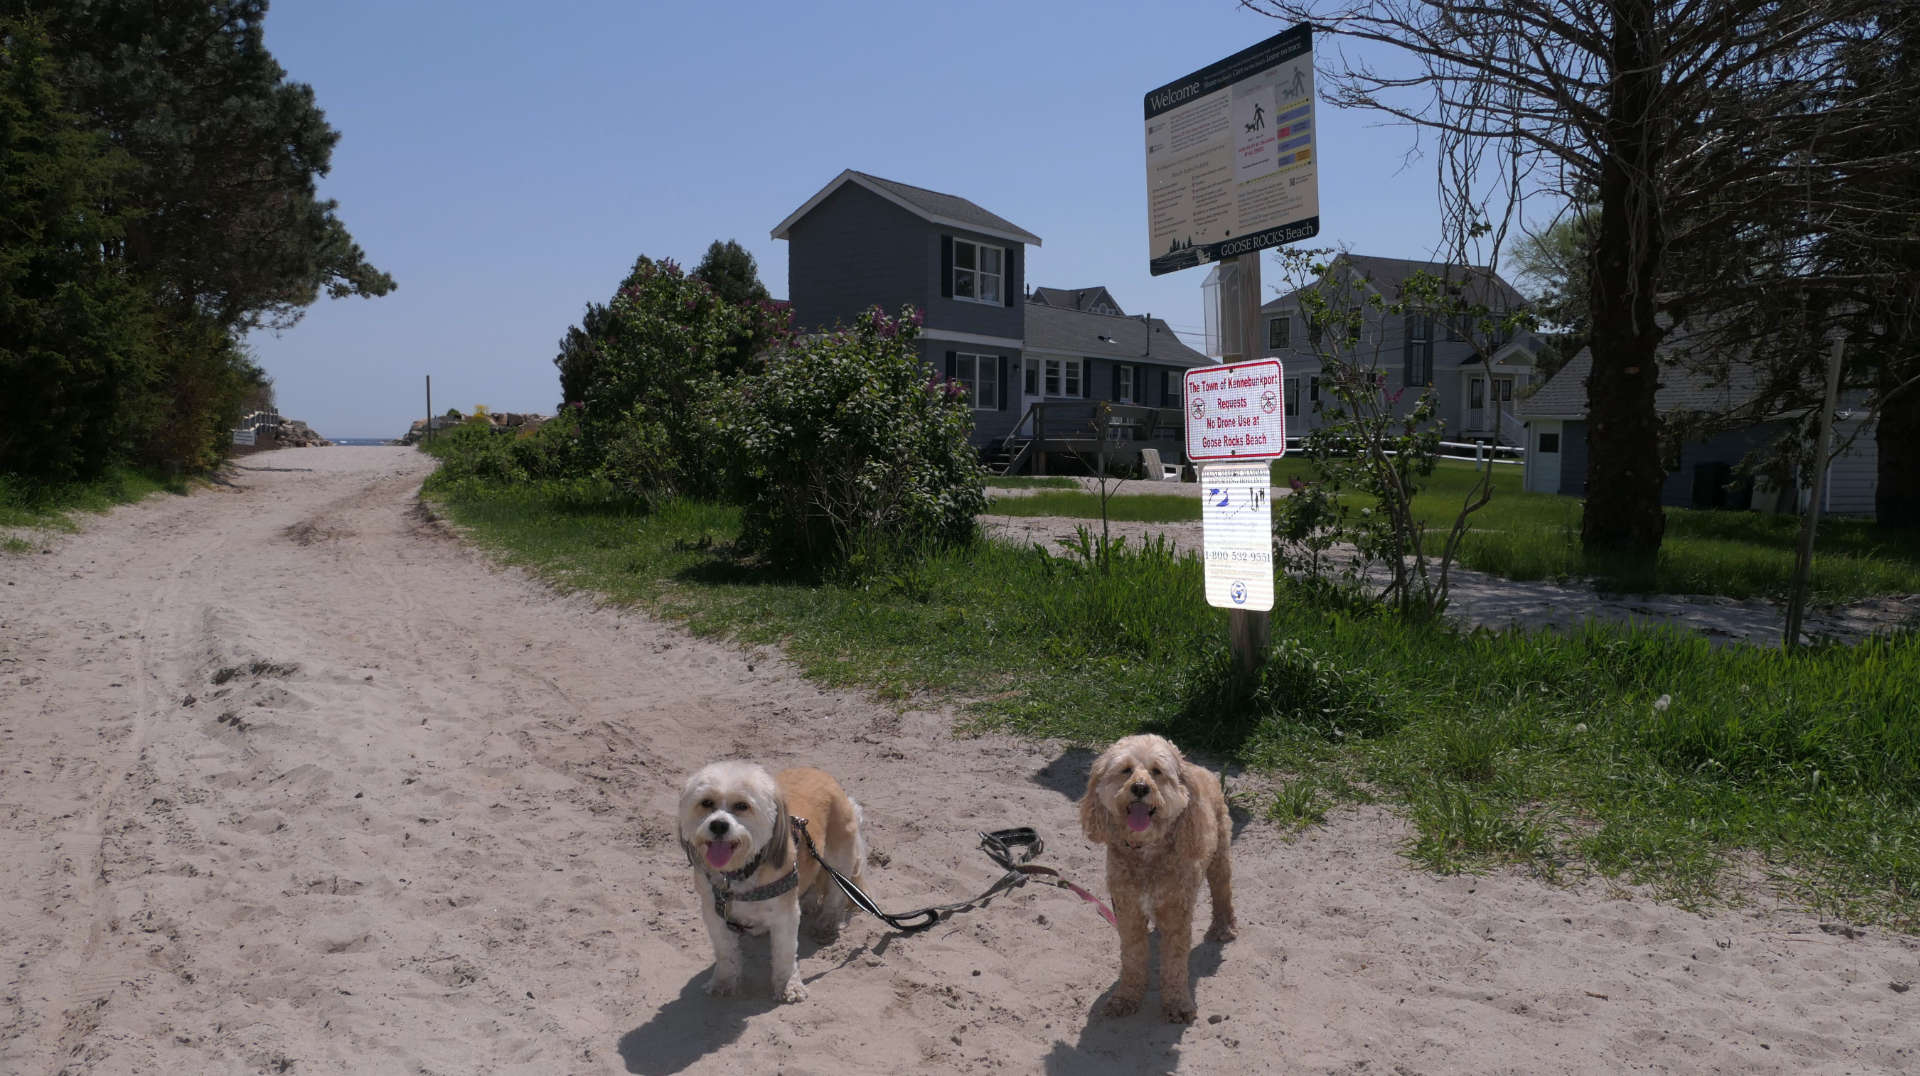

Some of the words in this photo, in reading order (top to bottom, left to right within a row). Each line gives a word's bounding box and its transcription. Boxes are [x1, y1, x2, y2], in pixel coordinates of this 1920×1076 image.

[1150, 81, 1200, 110] Welcome
[1221, 238, 1252, 256] GOOSE
[1253, 230, 1285, 249] ROCKS
[1286, 224, 1313, 242] Beach
[1189, 382, 1200, 393] The
[1202, 380, 1219, 391] Town
[1220, 379, 1226, 390] of
[1228, 374, 1278, 389] Kennebunkport
[1217, 398, 1247, 411] Requests
[1207, 418, 1215, 429] No
[1218, 417, 1236, 429] Drone
[1238, 416, 1251, 427] Use
[1252, 416, 1260, 427] at
[1202, 436, 1221, 448] Goose
[1224, 435, 1244, 447] Rocks
[1245, 433, 1267, 445] Beach
